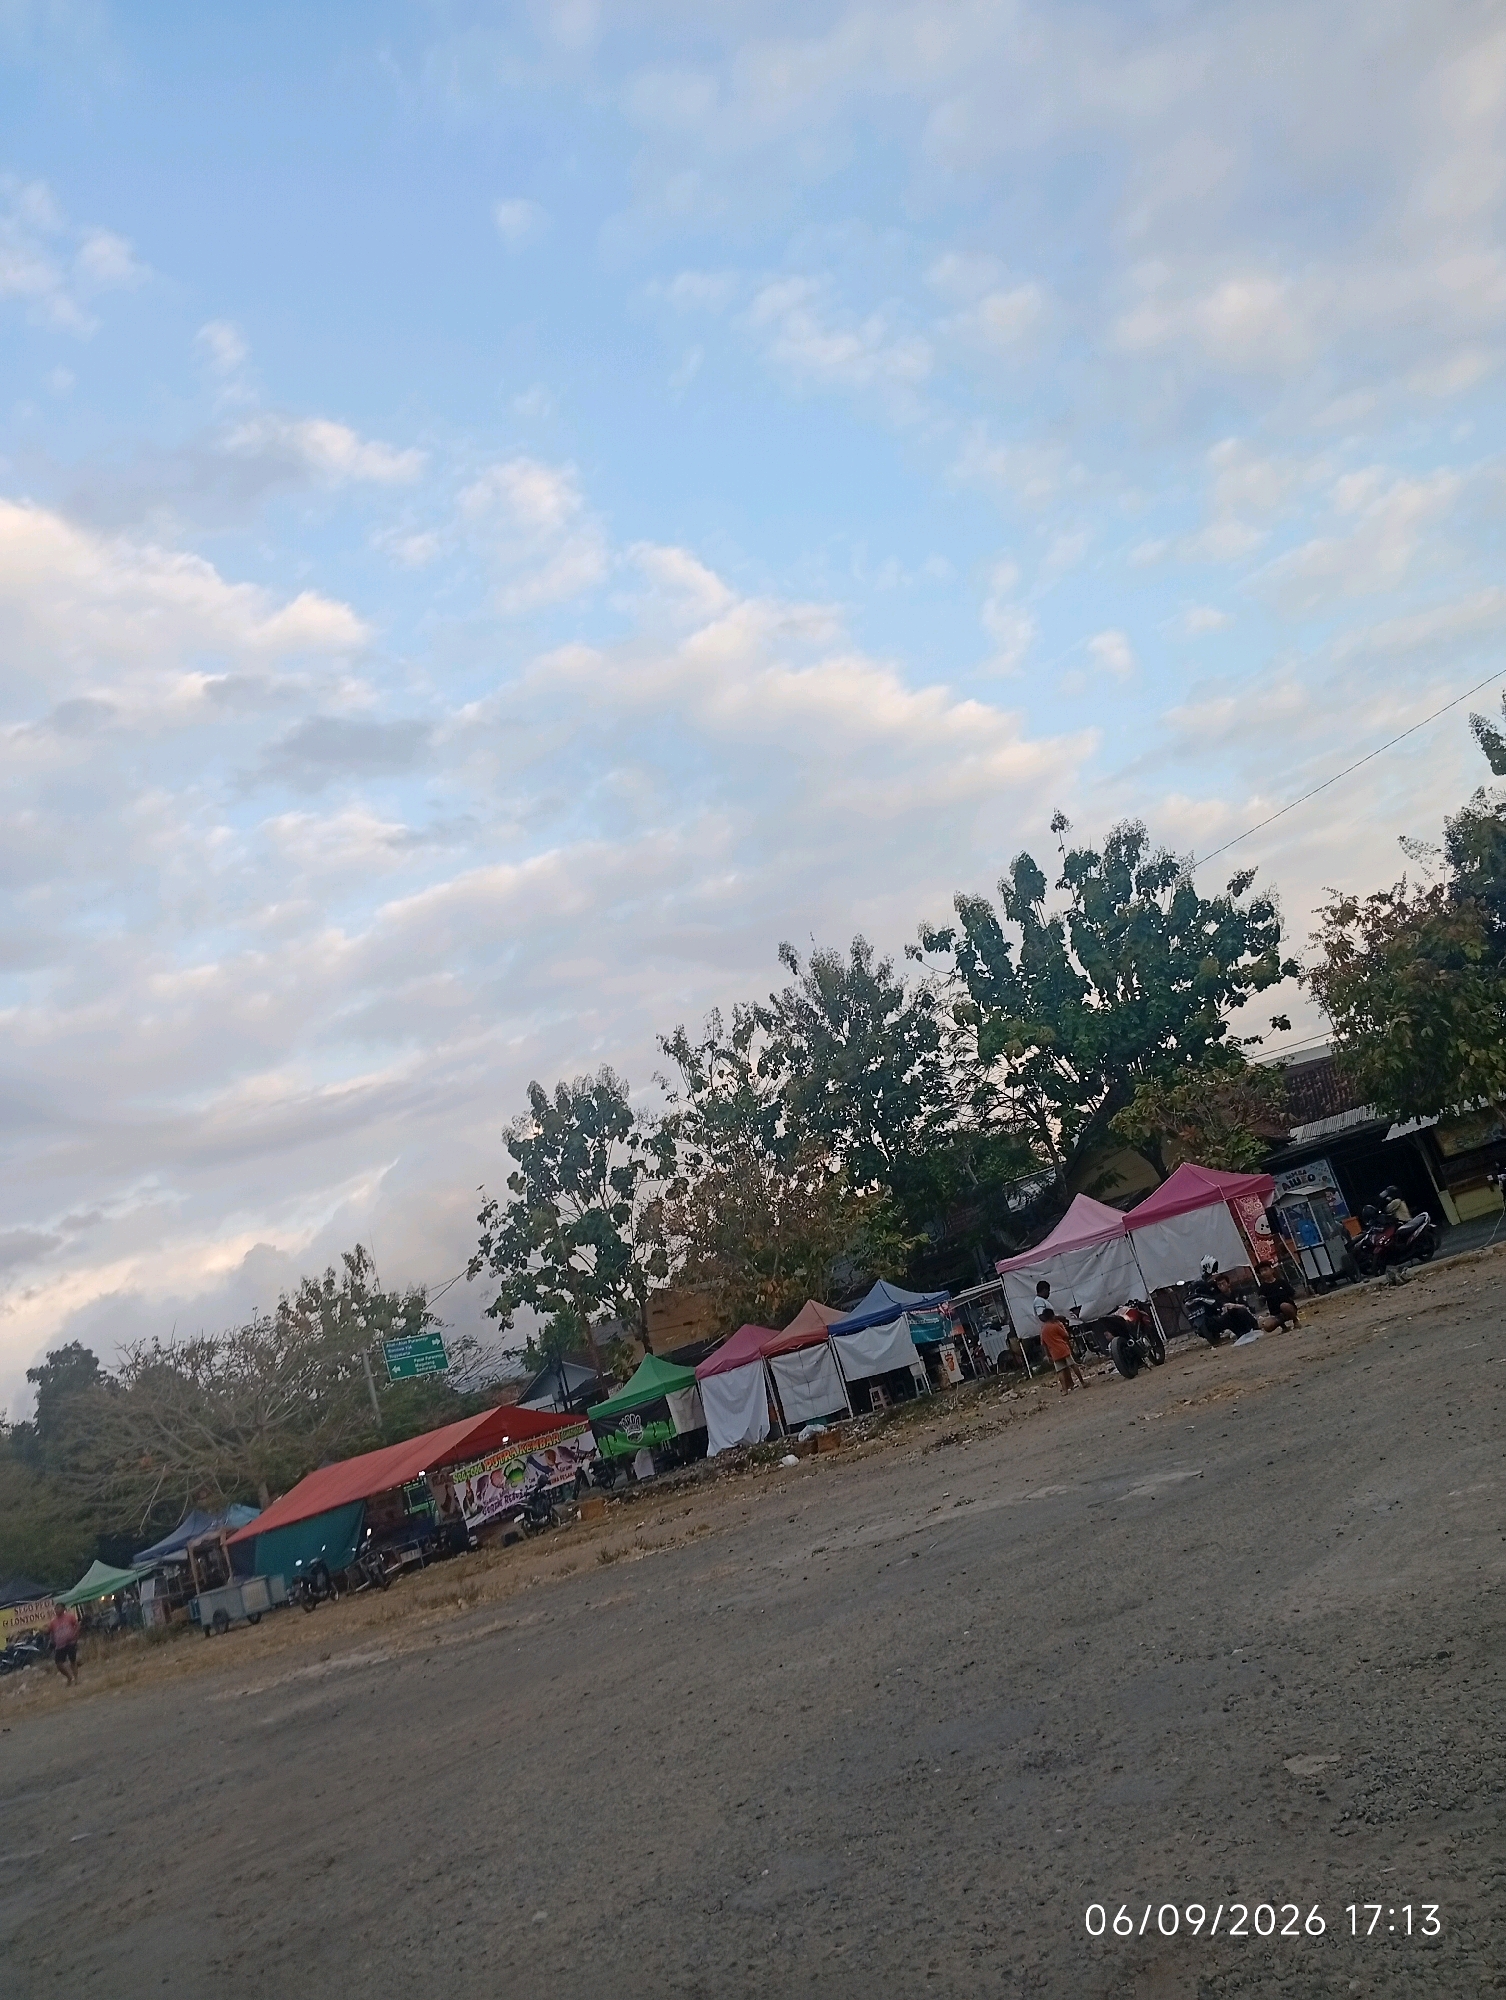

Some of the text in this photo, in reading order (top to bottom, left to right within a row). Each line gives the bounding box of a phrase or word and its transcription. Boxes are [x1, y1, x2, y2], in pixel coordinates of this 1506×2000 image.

[1281, 1174, 1316, 1191] AIUEO
[484, 1446, 519, 1471] PUTRA
[519, 1432, 560, 1455] KEMBAR
[10, 1613, 46, 1626] LONTONG
